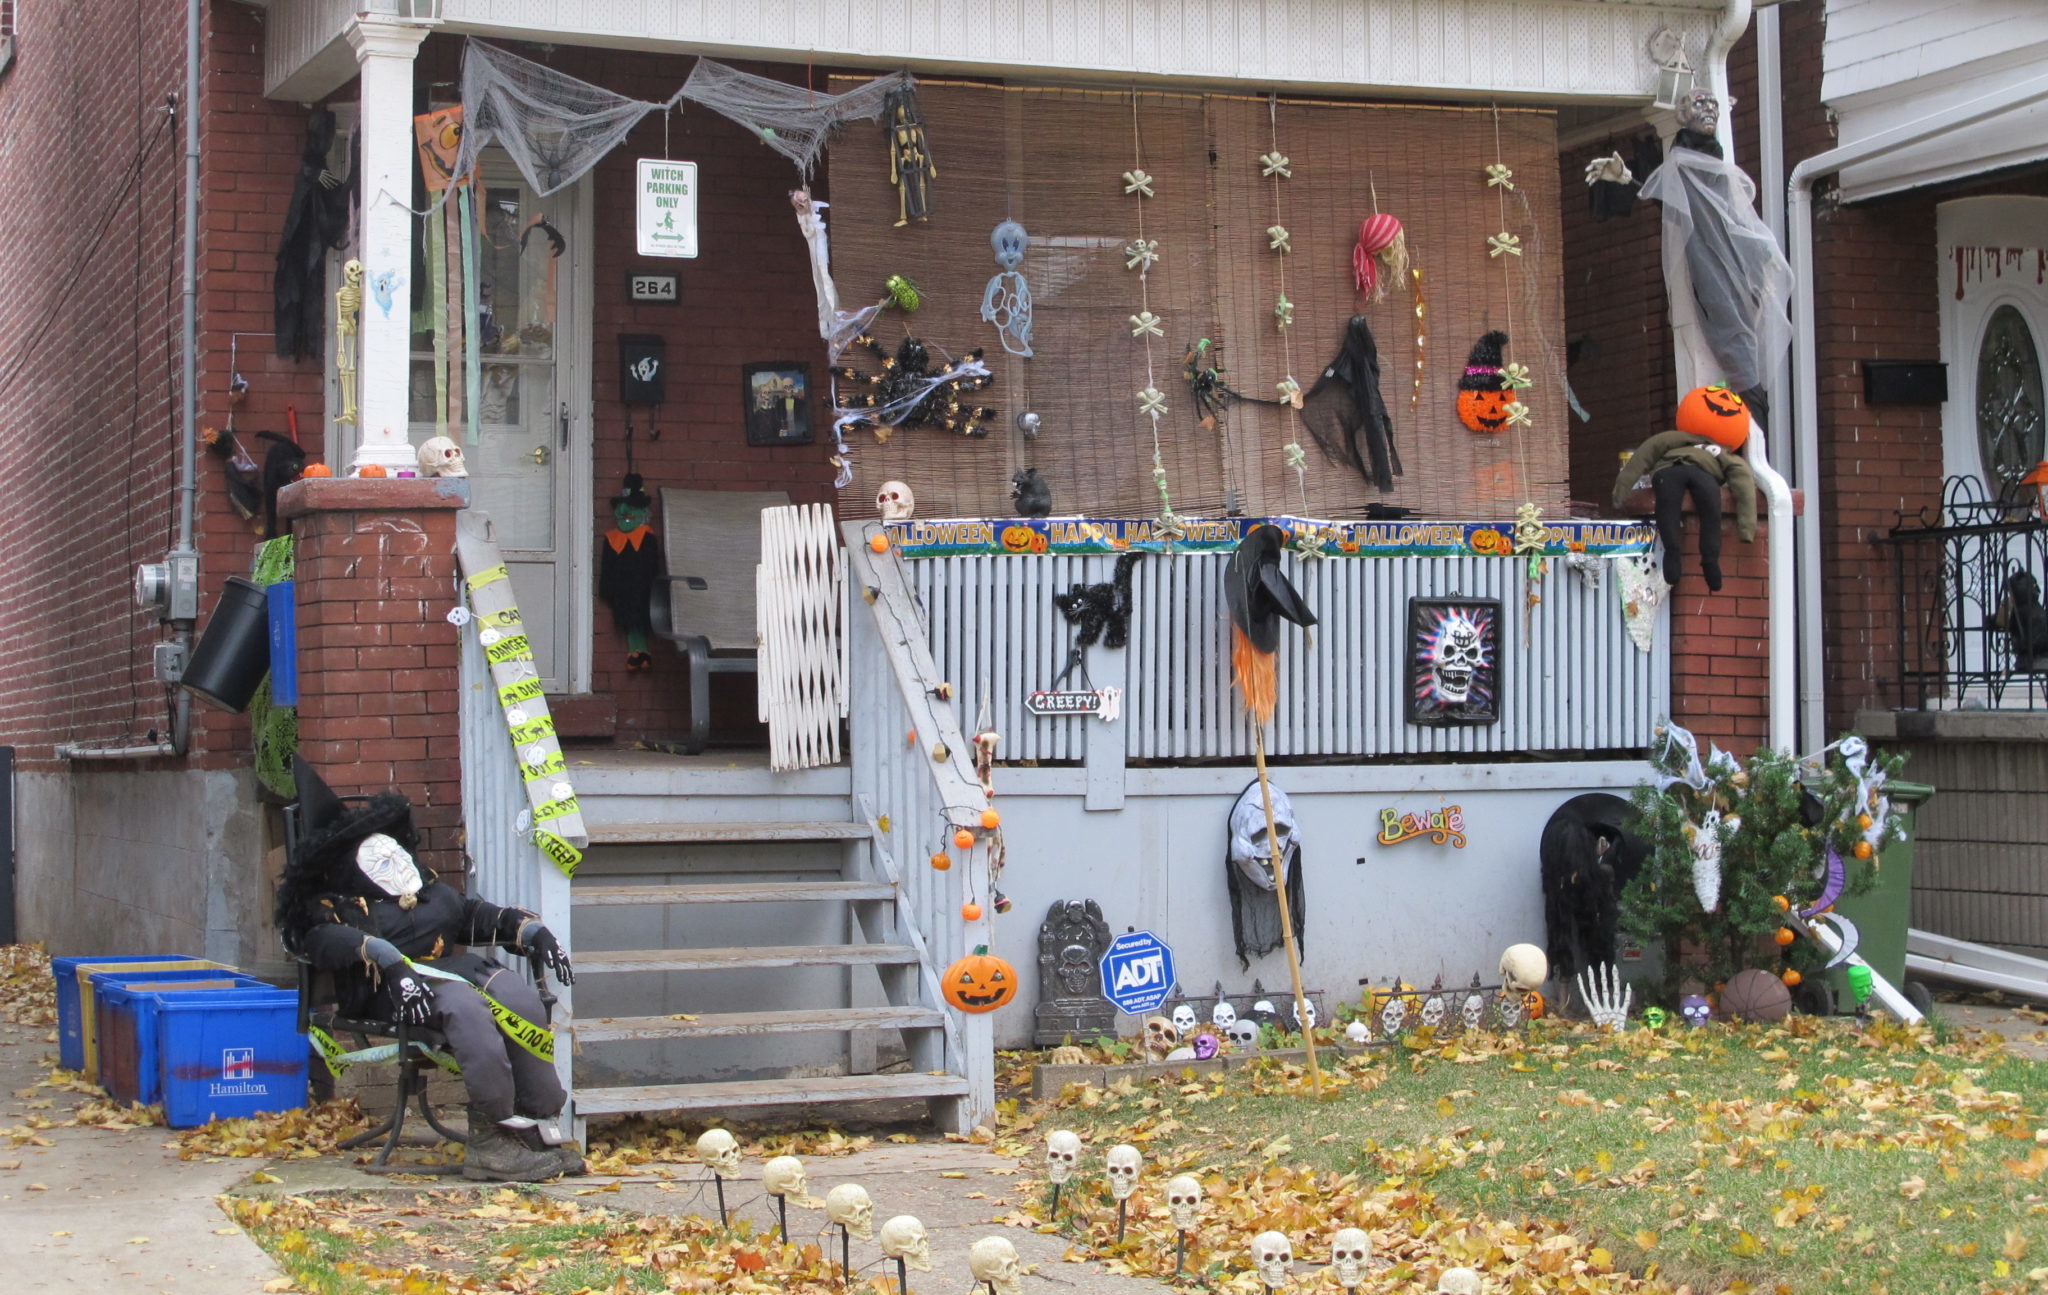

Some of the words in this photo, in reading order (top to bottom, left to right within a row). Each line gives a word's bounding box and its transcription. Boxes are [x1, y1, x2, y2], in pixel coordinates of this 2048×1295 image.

[651, 168, 684, 181] WITCH
[646, 182, 688, 195] PARKING
[655, 196, 679, 208] ONLY
[636, 281, 672, 295] 264
[889, 523, 994, 546] ALLOWEEN
[1051, 523, 1117, 545] HAPPY
[1354, 525, 1464, 546] HALLOWEEN
[1580, 525, 1655, 546] HALLOW
[1035, 694, 1098, 709] CREEPY!
[1380, 805, 1466, 841] Beware
[545, 838, 577, 865] KEEP
[1116, 940, 1143, 950] Secured
[1143, 938, 1152, 946] by
[1116, 955, 1161, 991] ADT
[210, 1081, 267, 1096] Hamilton
